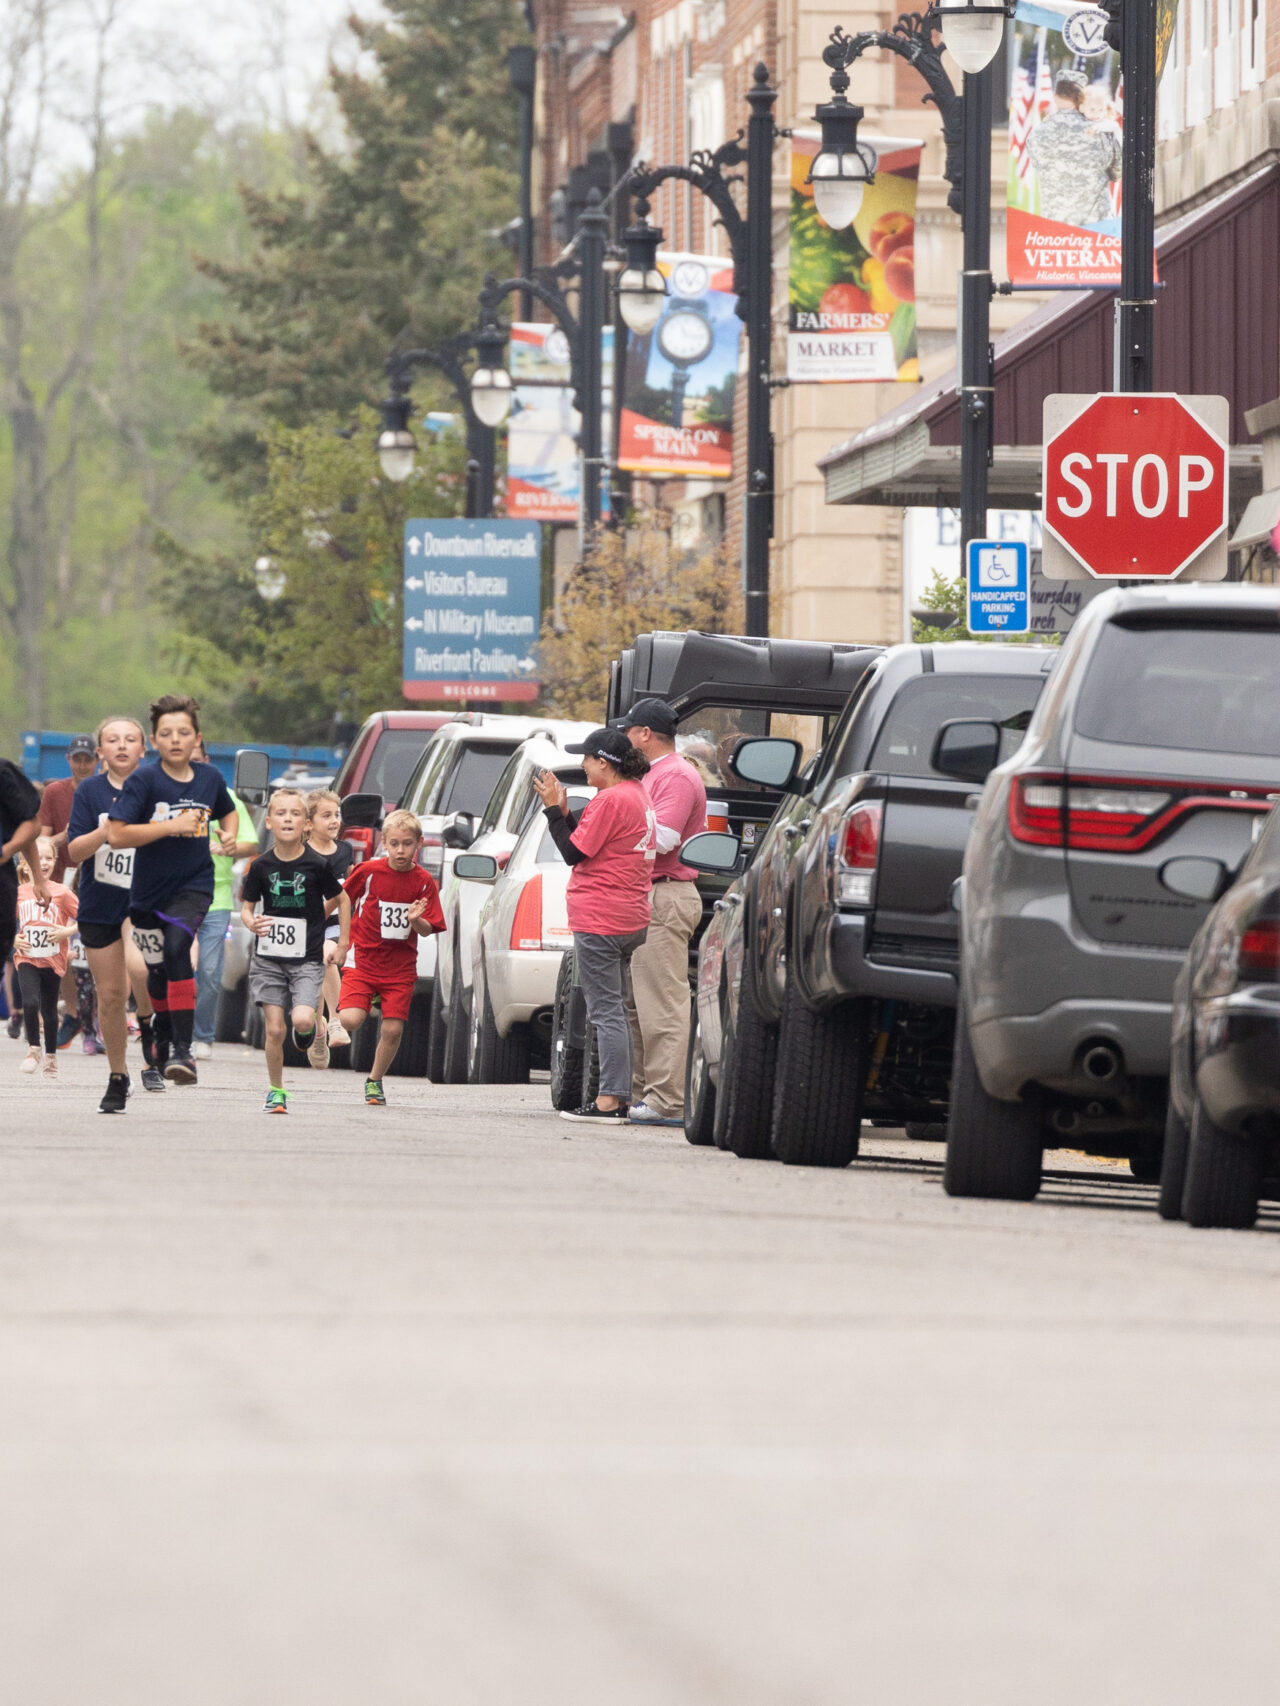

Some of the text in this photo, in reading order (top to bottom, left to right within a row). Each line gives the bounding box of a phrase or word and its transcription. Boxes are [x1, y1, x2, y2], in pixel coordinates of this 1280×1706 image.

[1025, 231, 1092, 251] Honoring
[1024, 249, 1122, 267] VETERAN
[1036, 270, 1076, 281] Historic
[796, 311, 890, 329] FARMERS'
[797, 341, 878, 357] MARKET
[633, 423, 720, 444] SPRING ON
[653, 439, 699, 456] MAIN
[1056, 452, 1214, 518] STOP
[424, 532, 538, 558] Downtown Riverwalk
[424, 571, 508, 596] Visitors Bureau
[971, 591, 1026, 602] HANDICAPPED
[981, 603, 1016, 613] PARKING
[424, 609, 534, 640] IN Military Museum
[988, 614, 1009, 625] ONLY
[415, 647, 518, 673] Riverfront Pavilion
[443, 686, 496, 697] WELCOME
[104, 852, 132, 876] 461
[27, 930, 55, 948] 132
[268, 924, 296, 946] 458
